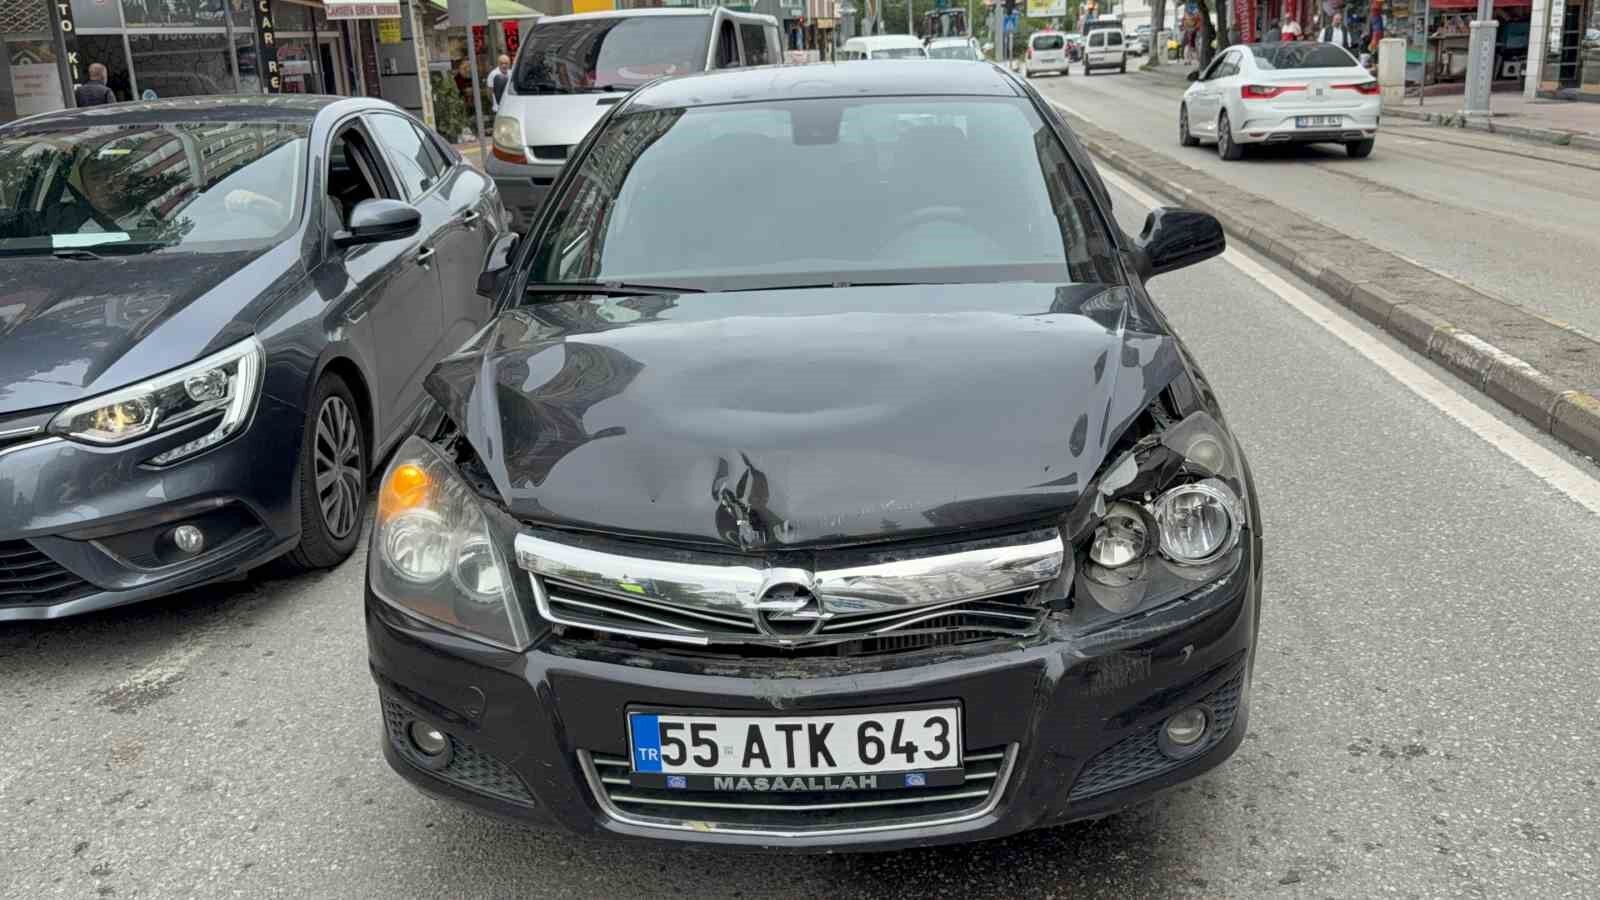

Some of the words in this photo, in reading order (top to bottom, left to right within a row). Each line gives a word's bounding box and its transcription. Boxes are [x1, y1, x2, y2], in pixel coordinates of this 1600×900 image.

[259, 0, 274, 44] CAR
[638, 747, 659, 761] TR
[659, 721, 719, 768] 55
[741, 722, 837, 769] ATK
[857, 715, 951, 766] 643
